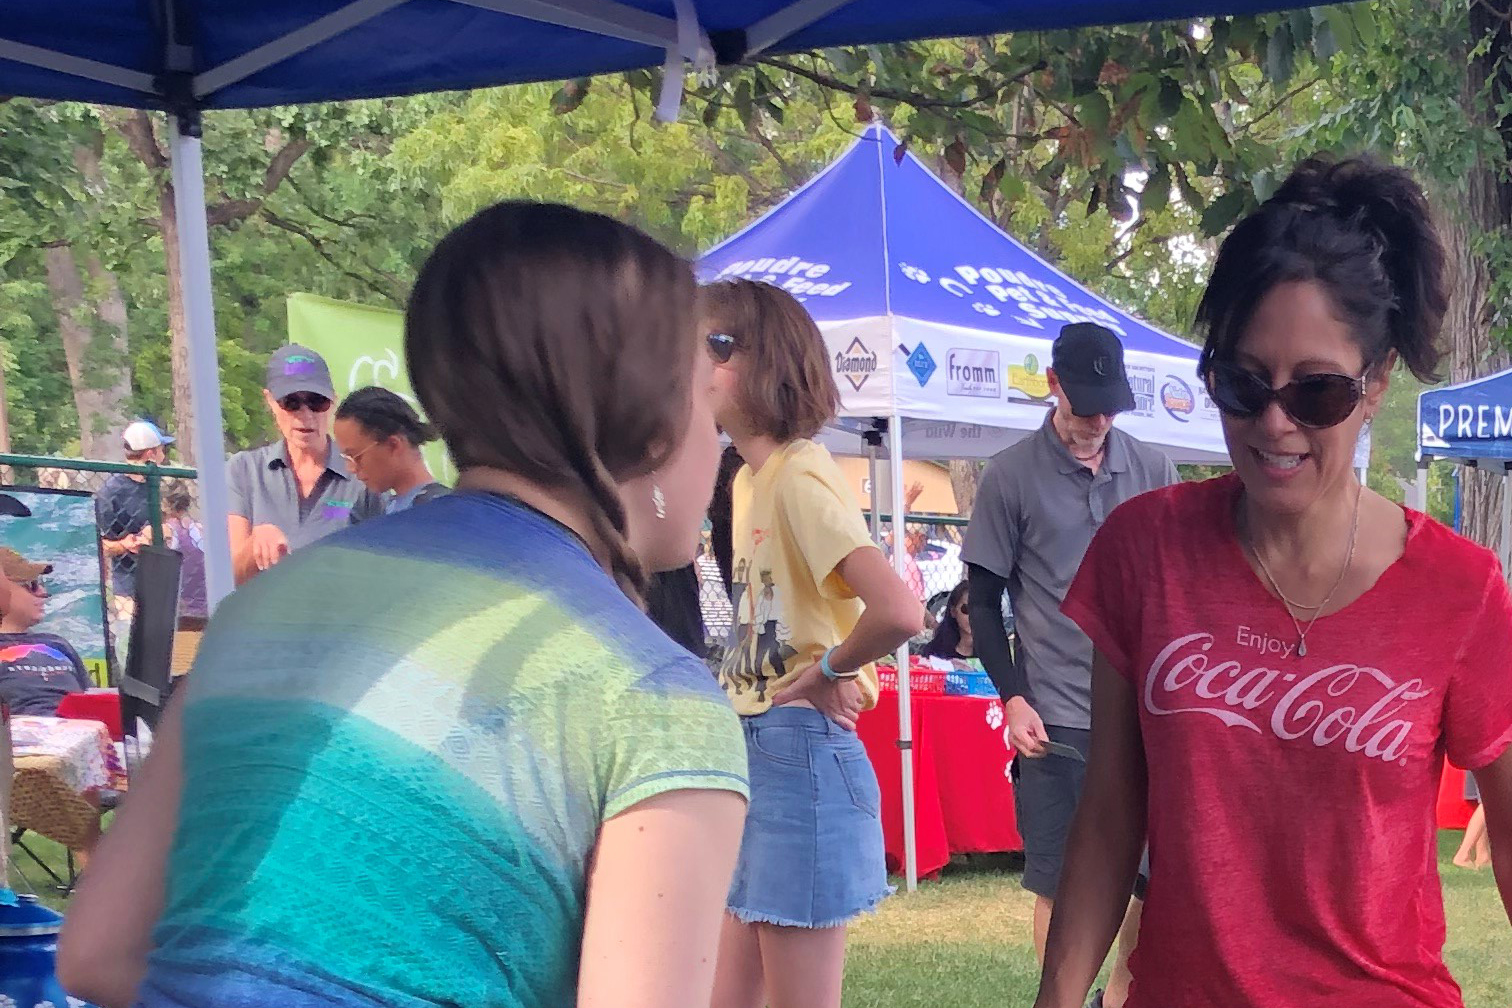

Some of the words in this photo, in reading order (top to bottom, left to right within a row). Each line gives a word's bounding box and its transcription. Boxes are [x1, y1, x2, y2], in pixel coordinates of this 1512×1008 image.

[835, 350, 877, 374] Diamond
[949, 353, 996, 384] fromm
[1236, 625, 1295, 659] Enjoy
[1145, 632, 1434, 764] Coca-Cola
